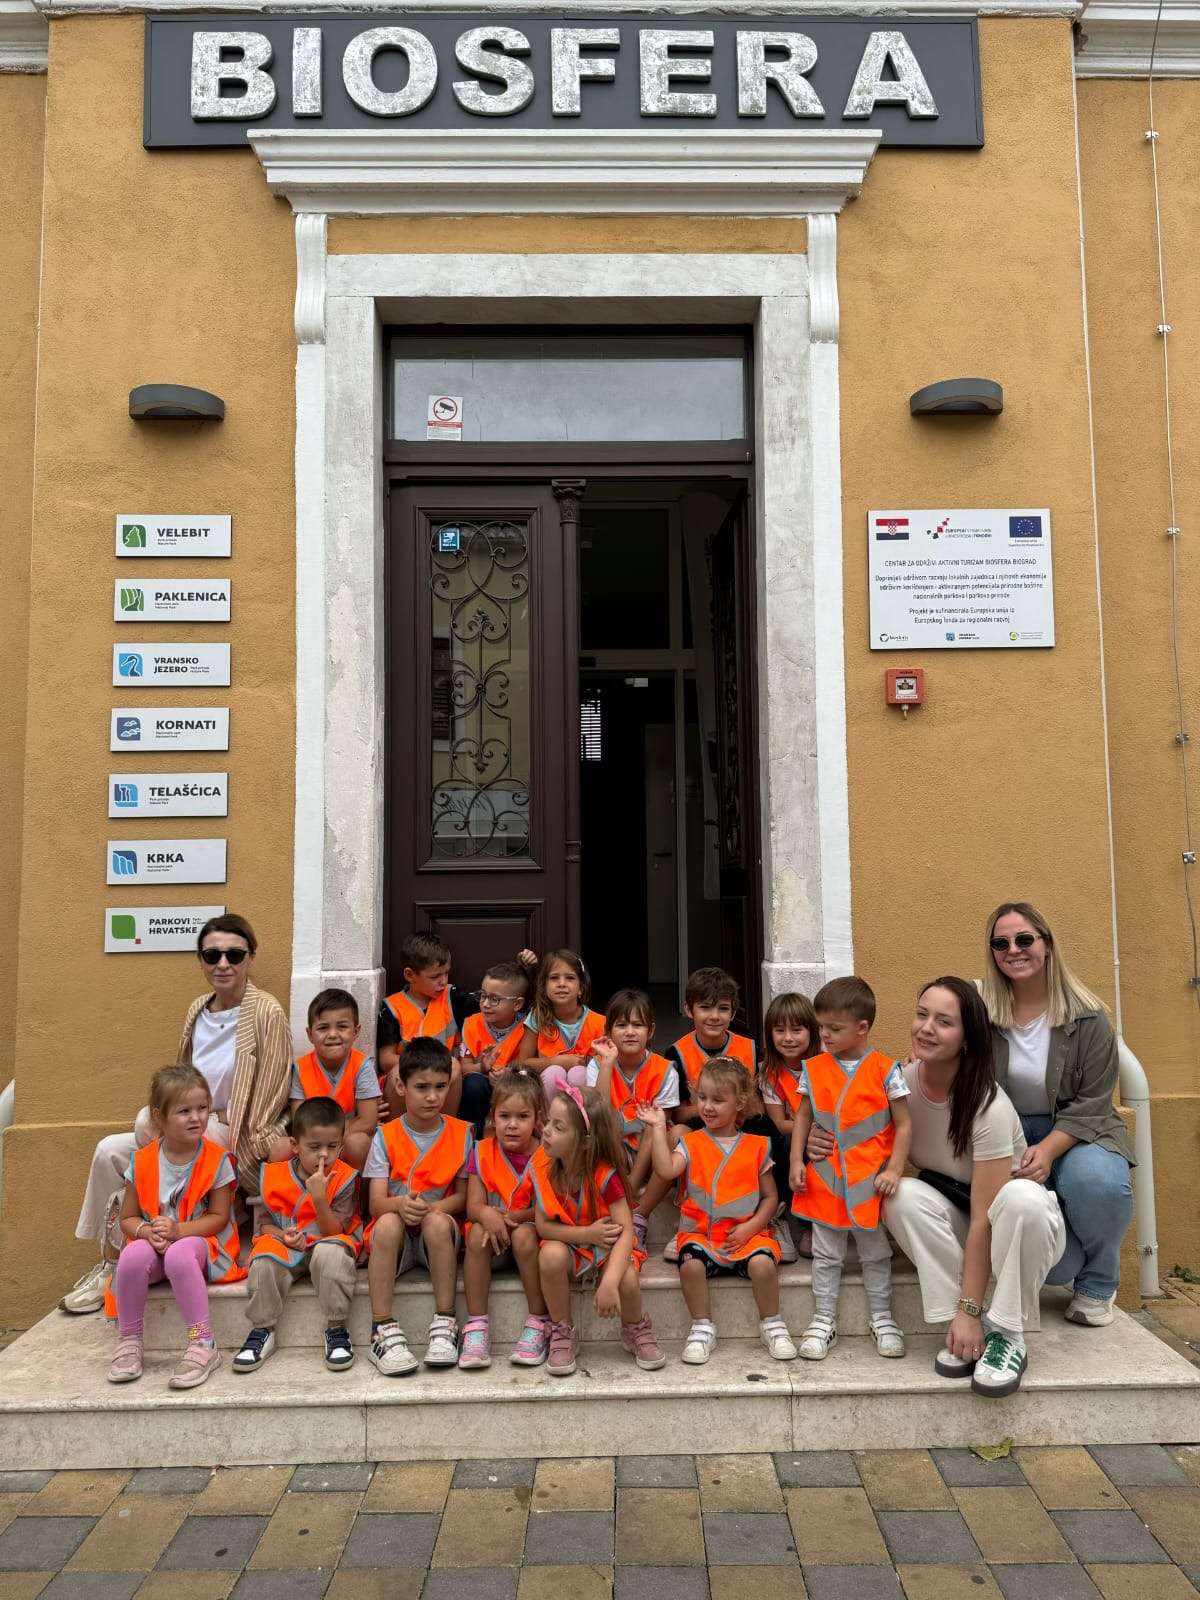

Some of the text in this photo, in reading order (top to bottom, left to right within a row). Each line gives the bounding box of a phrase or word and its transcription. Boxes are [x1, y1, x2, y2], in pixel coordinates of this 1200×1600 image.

[191, 27, 939, 121] BIOSFERA
[157, 528, 210, 538] VELEBIT
[907, 559, 915, 567] ZA
[916, 559, 936, 567] ODRŽIVI
[938, 559, 960, 567] AKTIVNI
[1012, 558, 1037, 566] BIOGRAD
[155, 592, 227, 602] PAKLENICA
[154, 657, 199, 665] VRANSKO
[154, 666, 188, 674] JEZERO
[156, 720, 216, 730] KORNATI
[149, 784, 221, 796] TELAŠĆICA
[147, 853, 184, 863] KRKA
[149, 917, 190, 926] PARKOVI
[149, 927, 197, 935] HRVATSKE
